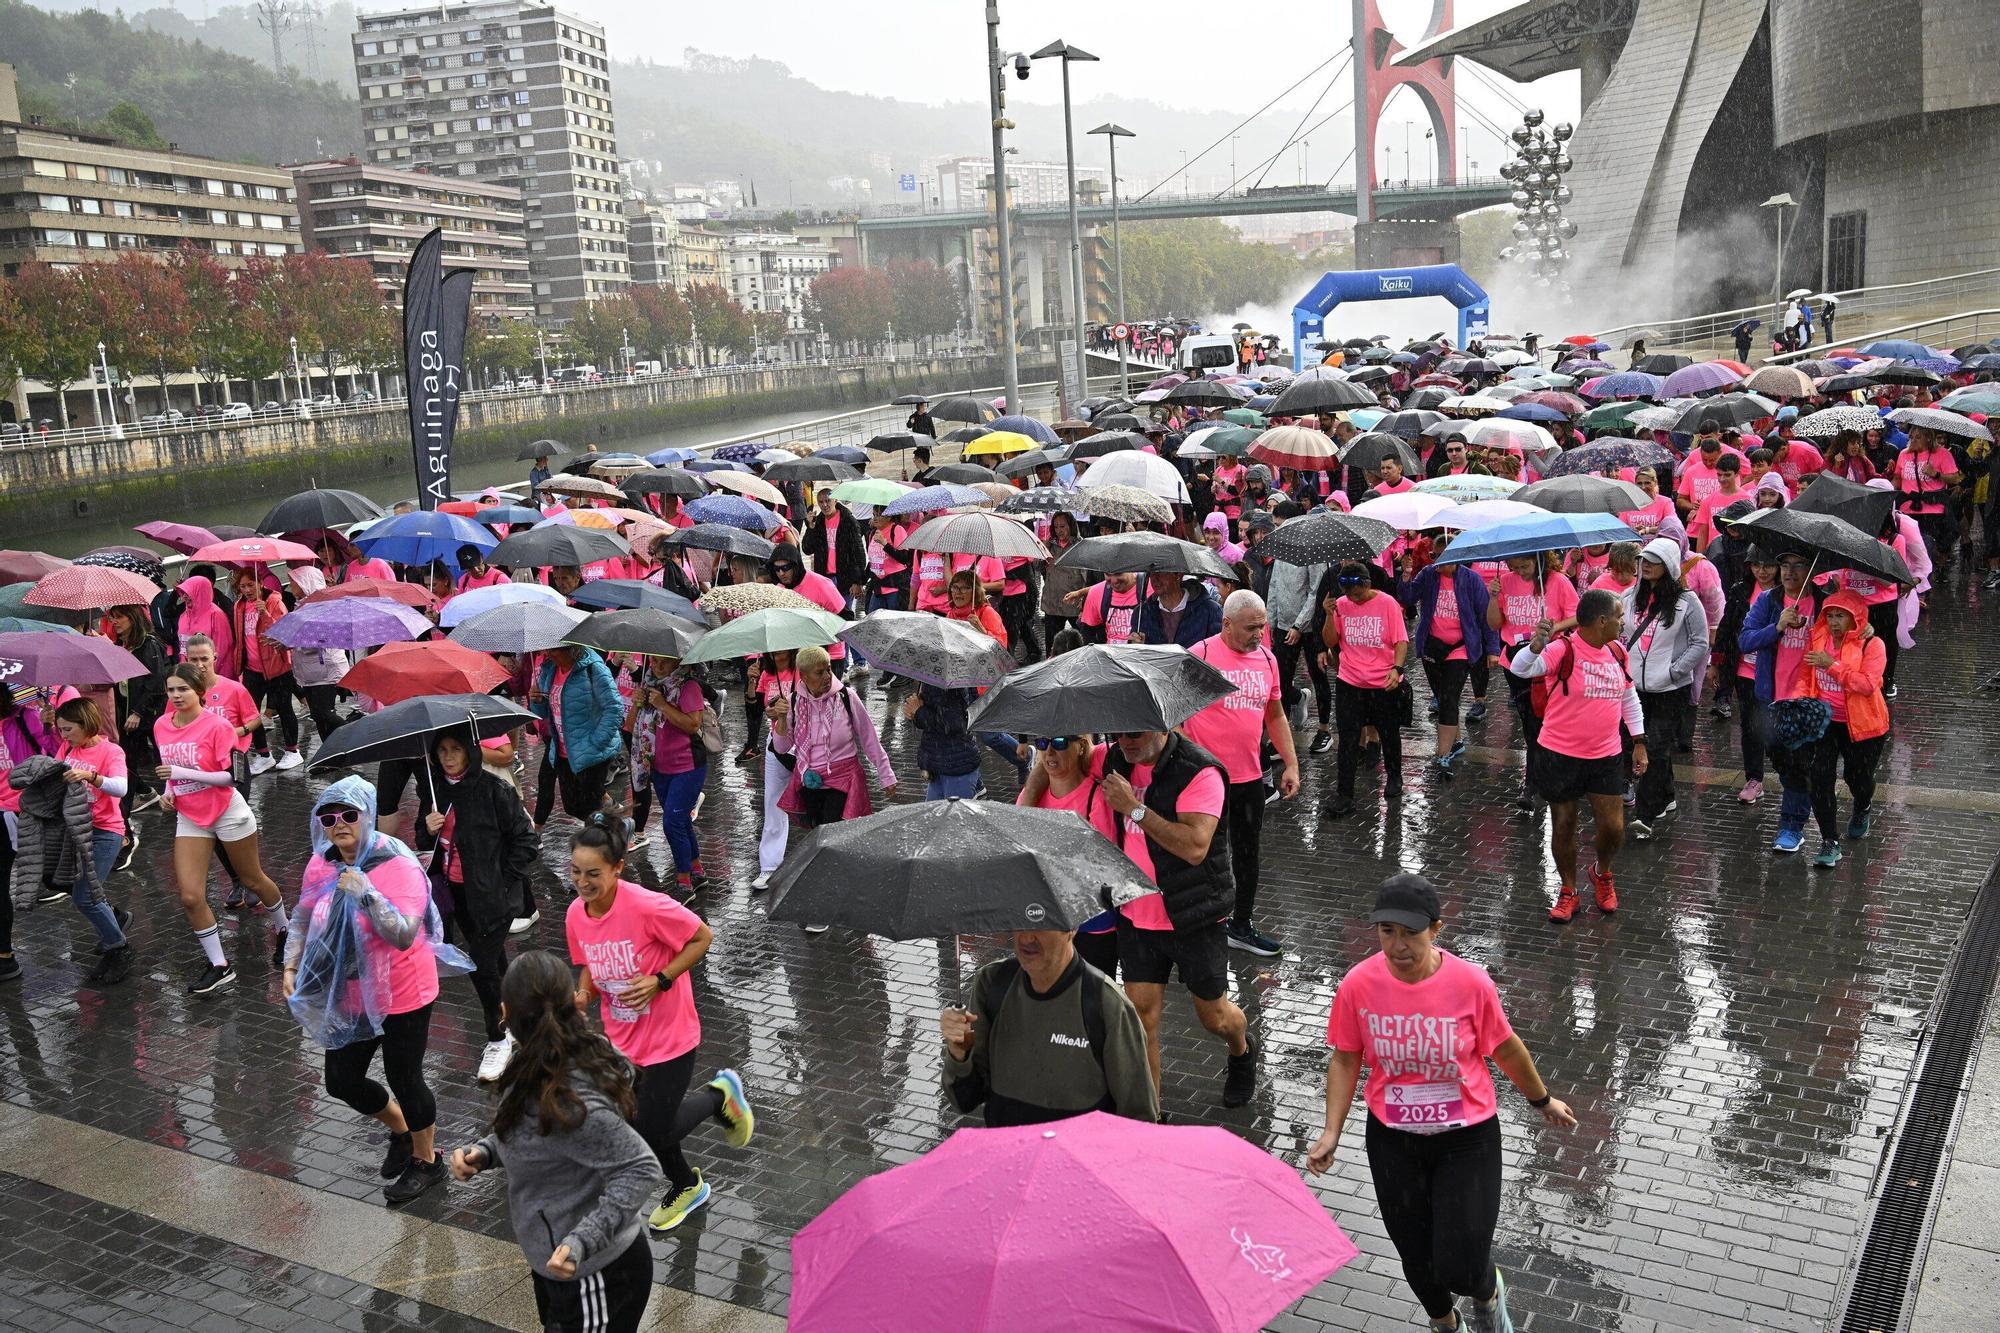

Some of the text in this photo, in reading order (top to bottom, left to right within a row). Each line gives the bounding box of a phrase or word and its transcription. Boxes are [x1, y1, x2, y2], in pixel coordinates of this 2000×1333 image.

[1382, 279, 1410, 290] Kaiku
[421, 330, 448, 499] Aguinaga
[1850, 580, 1868, 588] 2025
[1027, 909, 1044, 917] CHR
[1050, 1033, 1090, 1049] NikeAir
[1400, 1104, 1449, 1122] 2025
